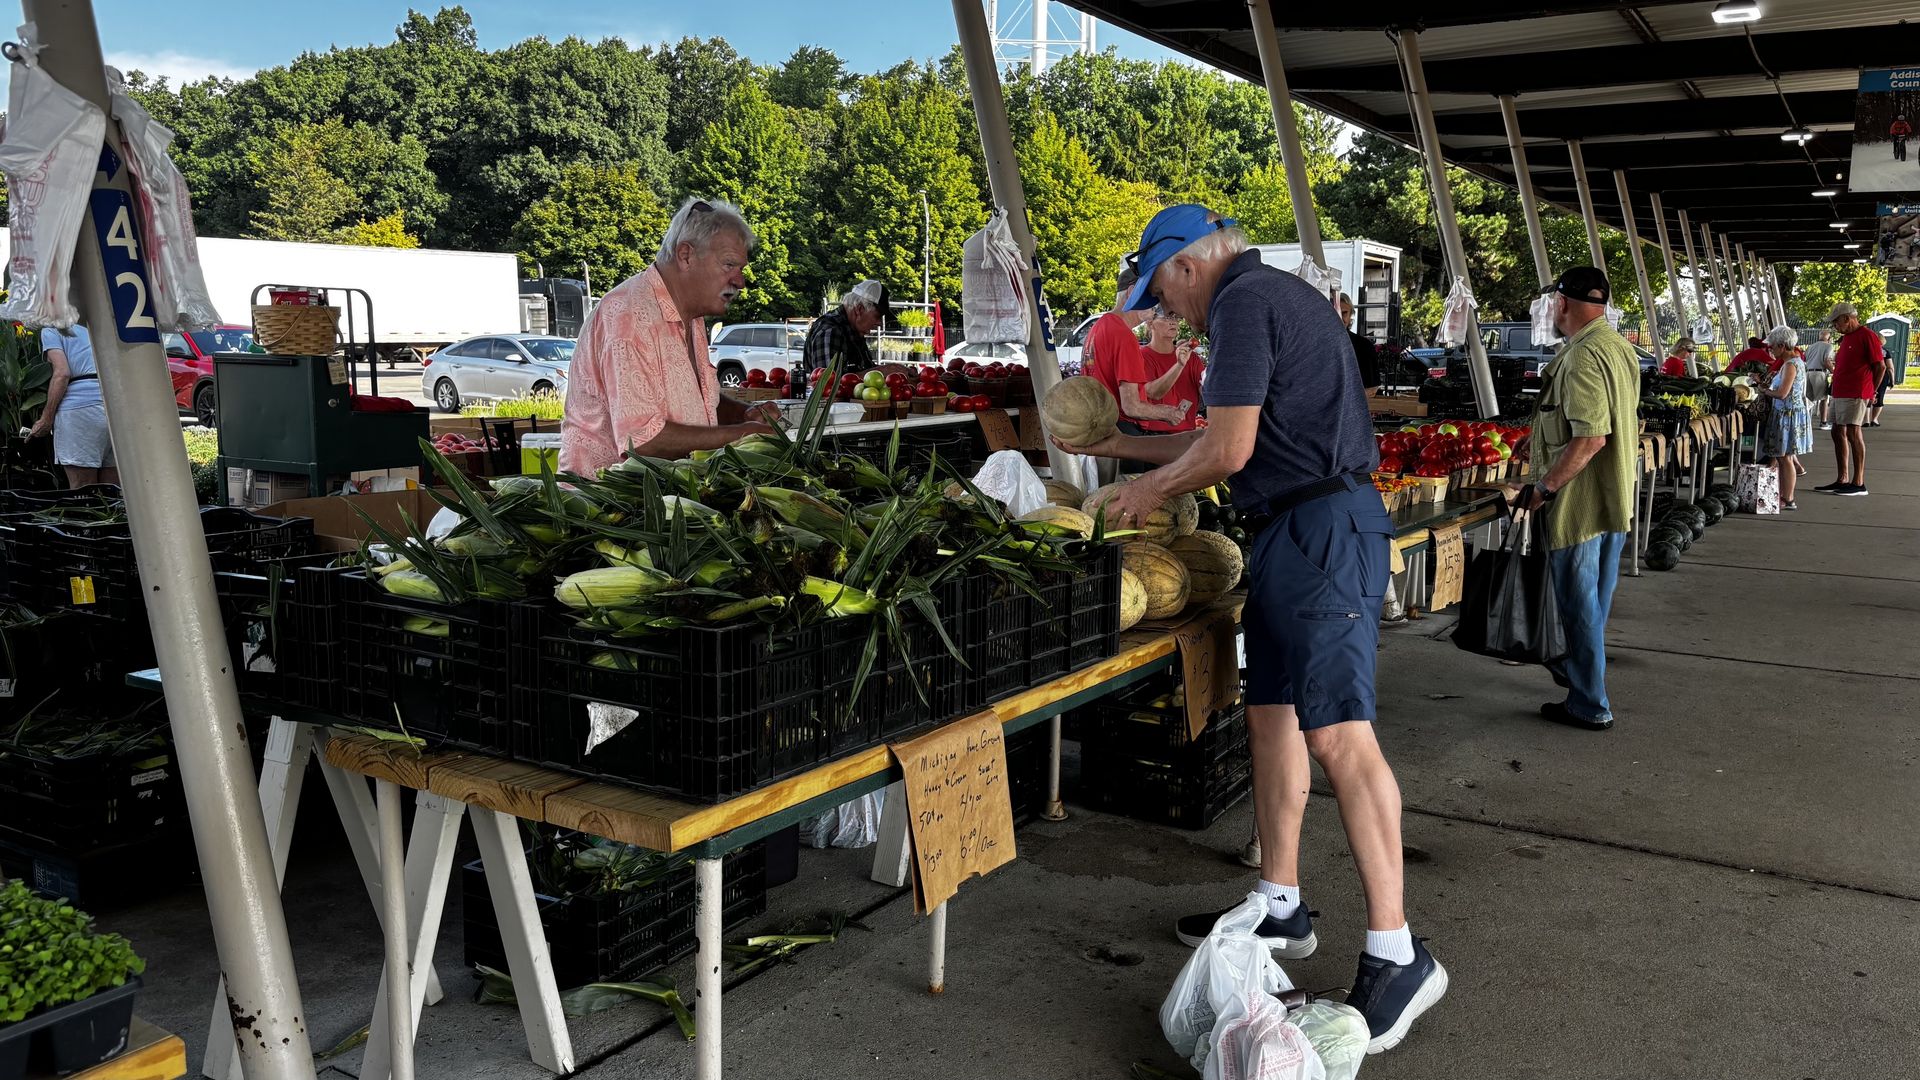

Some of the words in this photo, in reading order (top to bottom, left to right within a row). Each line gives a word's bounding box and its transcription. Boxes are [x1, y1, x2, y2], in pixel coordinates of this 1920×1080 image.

[920, 751, 957, 772] Michigan
[980, 729, 1002, 750] Grown
[950, 771, 967, 788] Cream
